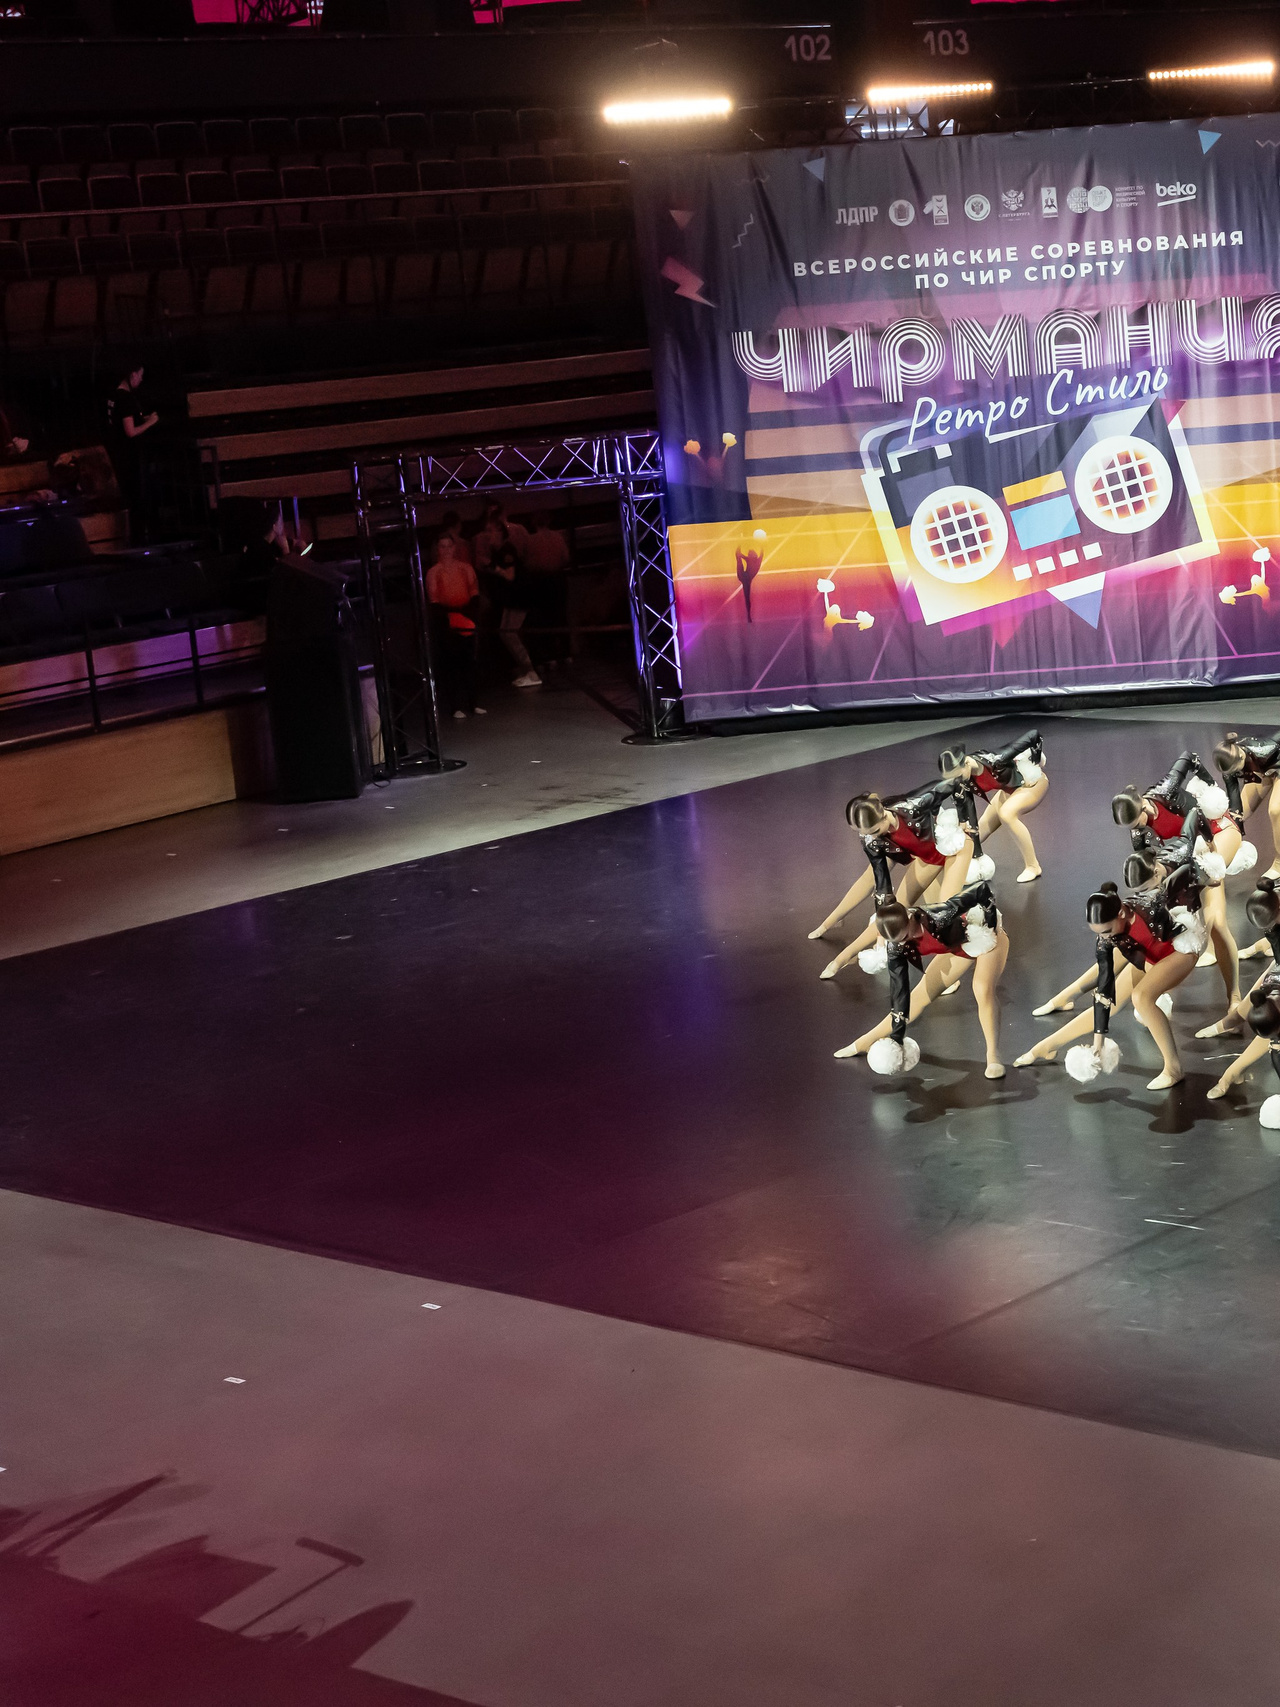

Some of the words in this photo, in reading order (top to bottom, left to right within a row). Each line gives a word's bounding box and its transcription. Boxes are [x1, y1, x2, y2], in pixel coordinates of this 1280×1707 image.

[785, 34, 832, 61] 102
[923, 29, 969, 56] 103
[1155, 181, 1197, 197] beko
[835, 206, 879, 226] ЛДПР
[793, 248, 1019, 277] ВСЕРОССИЙСКИЕ
[1031, 230, 1244, 260] СОРЕВНОВАНИЯ
[914, 272, 949, 290] ПО
[961, 269, 1012, 285] ЧИР
[1024, 259, 1126, 282] СПОРТУ
[908, 396, 1030, 445] Ретро
[1046, 367, 1170, 416] Стиль
